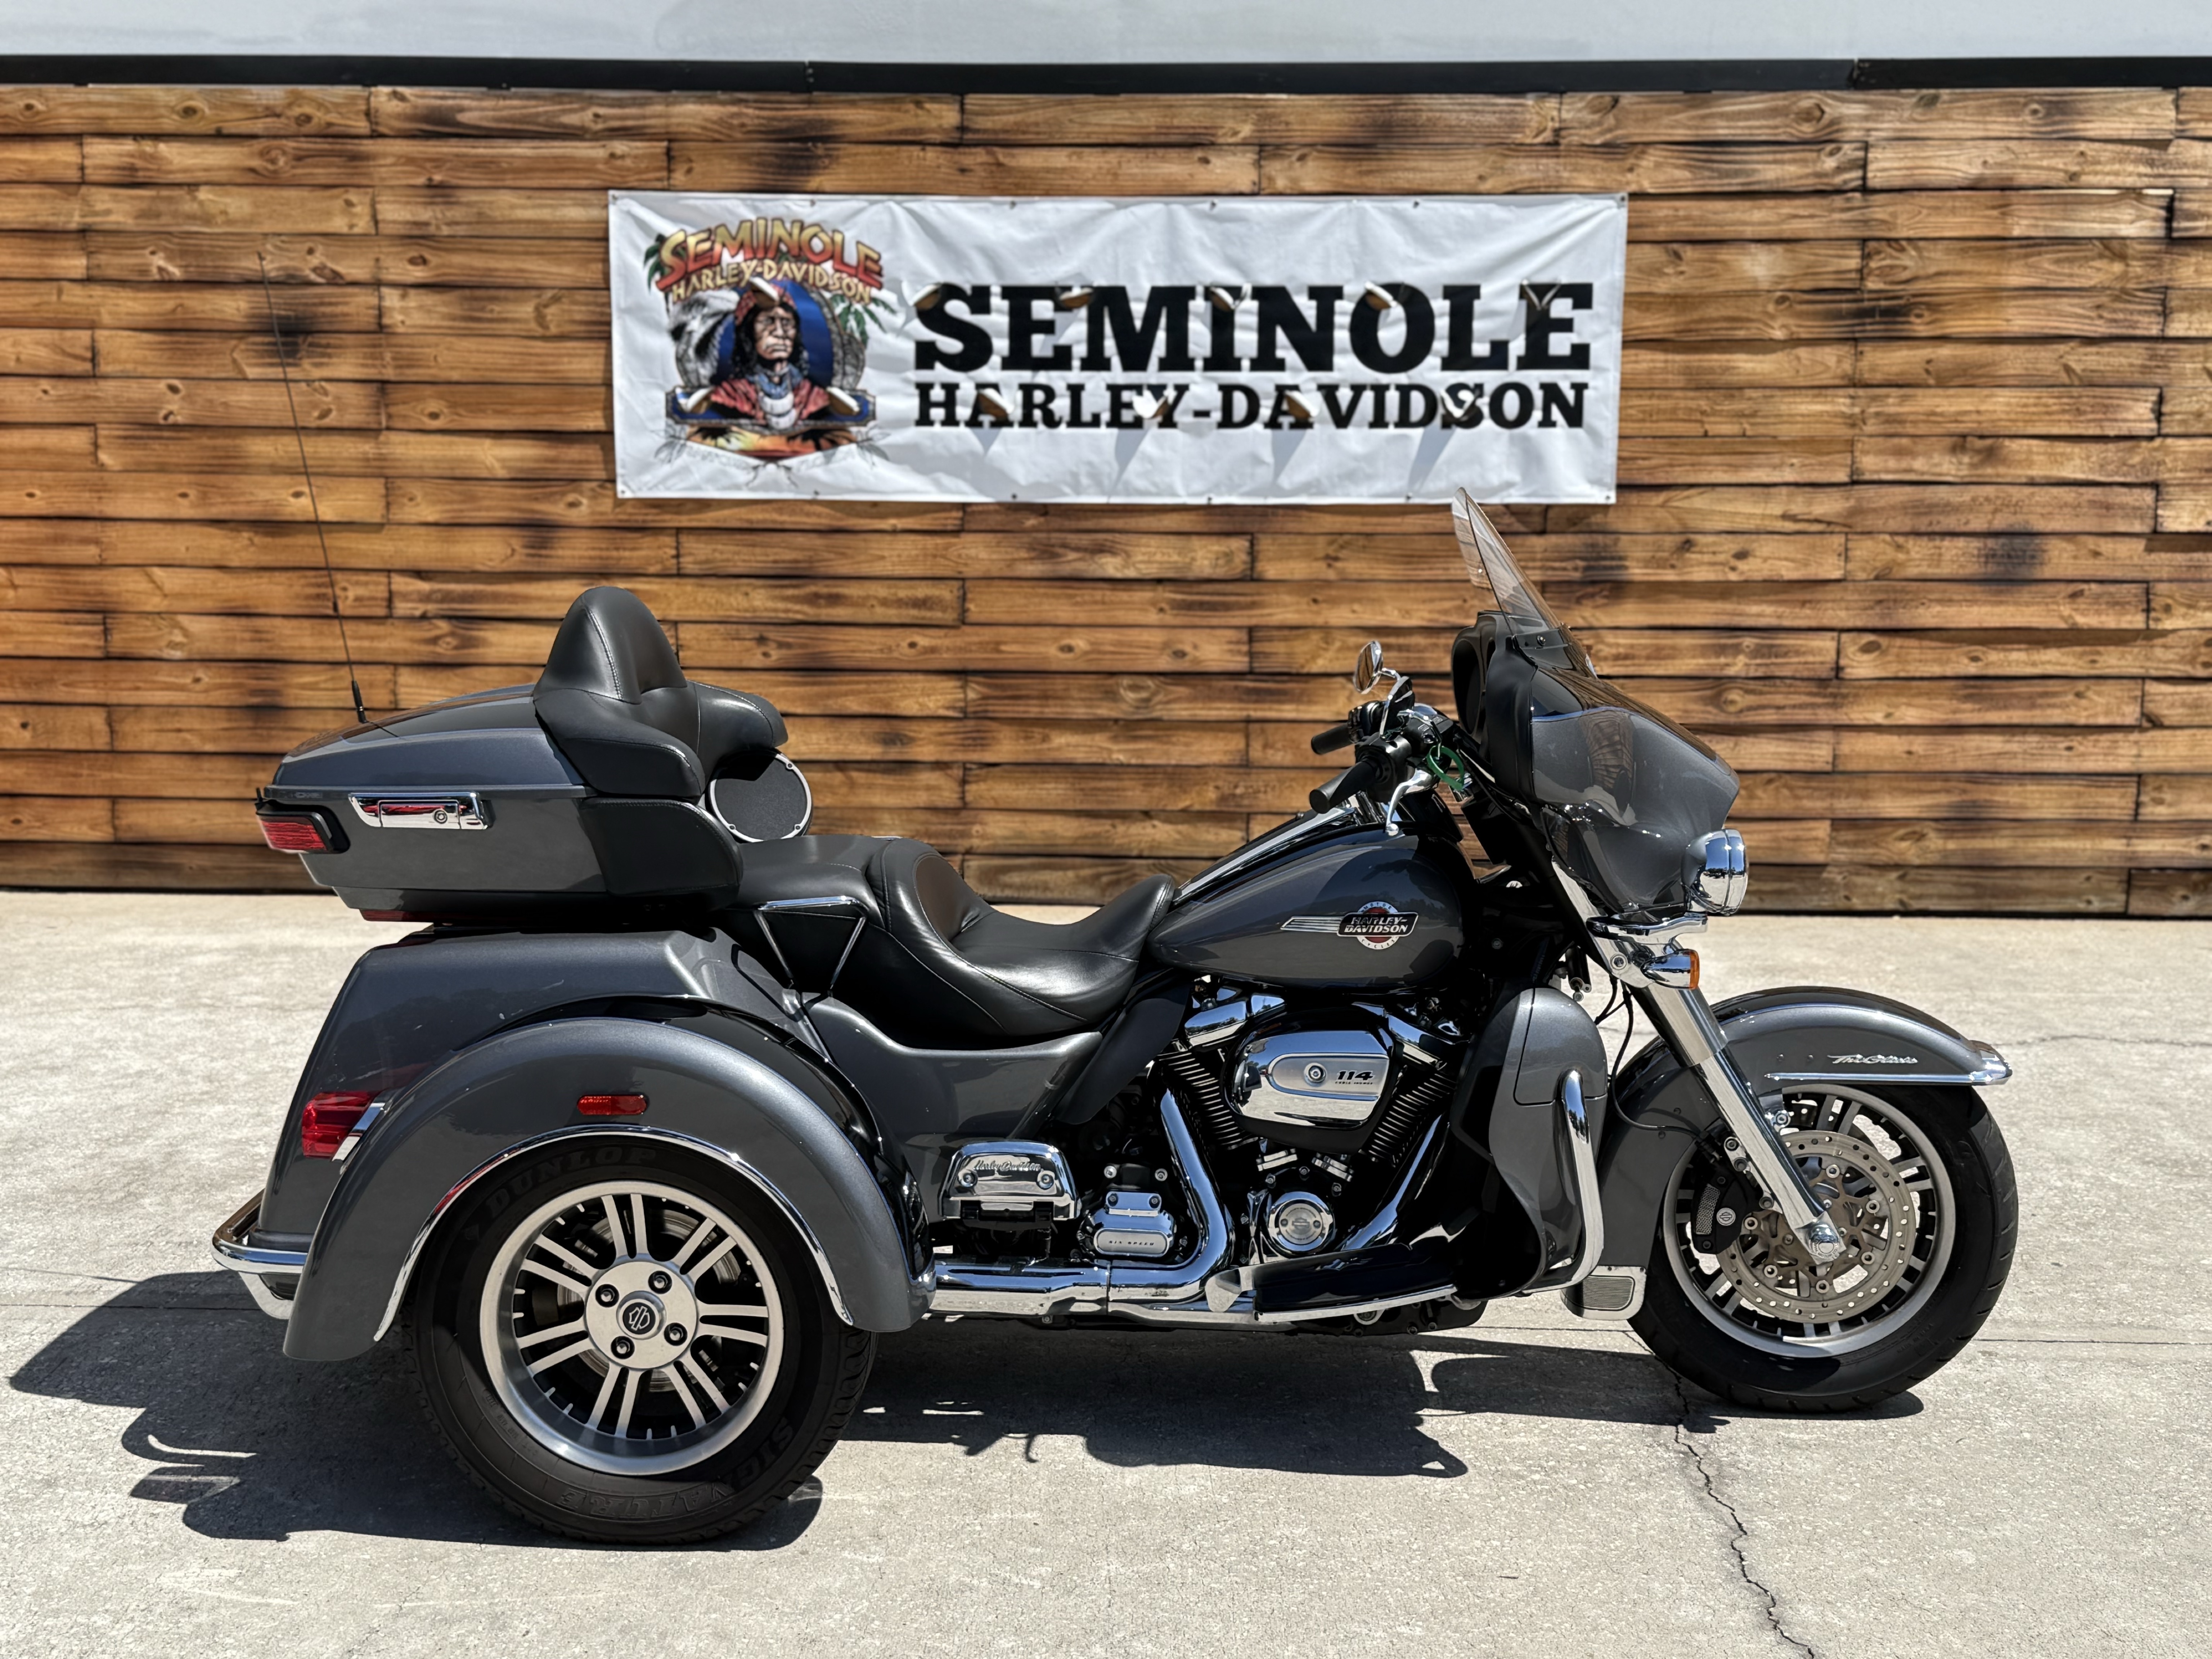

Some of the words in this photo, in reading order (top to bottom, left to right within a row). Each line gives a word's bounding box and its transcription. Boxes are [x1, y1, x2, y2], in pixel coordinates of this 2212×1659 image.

[655, 217, 884, 291] SEMINOLE
[671, 258, 872, 304] HARLEY-DAVIDSON
[915, 283, 1593, 374] SEMINOLE
[915, 382, 1588, 430] HARLEY-DAVIDSON
[1337, 1070, 1374, 1080] 114
[486, 1146, 656, 1218] DUNLOP
